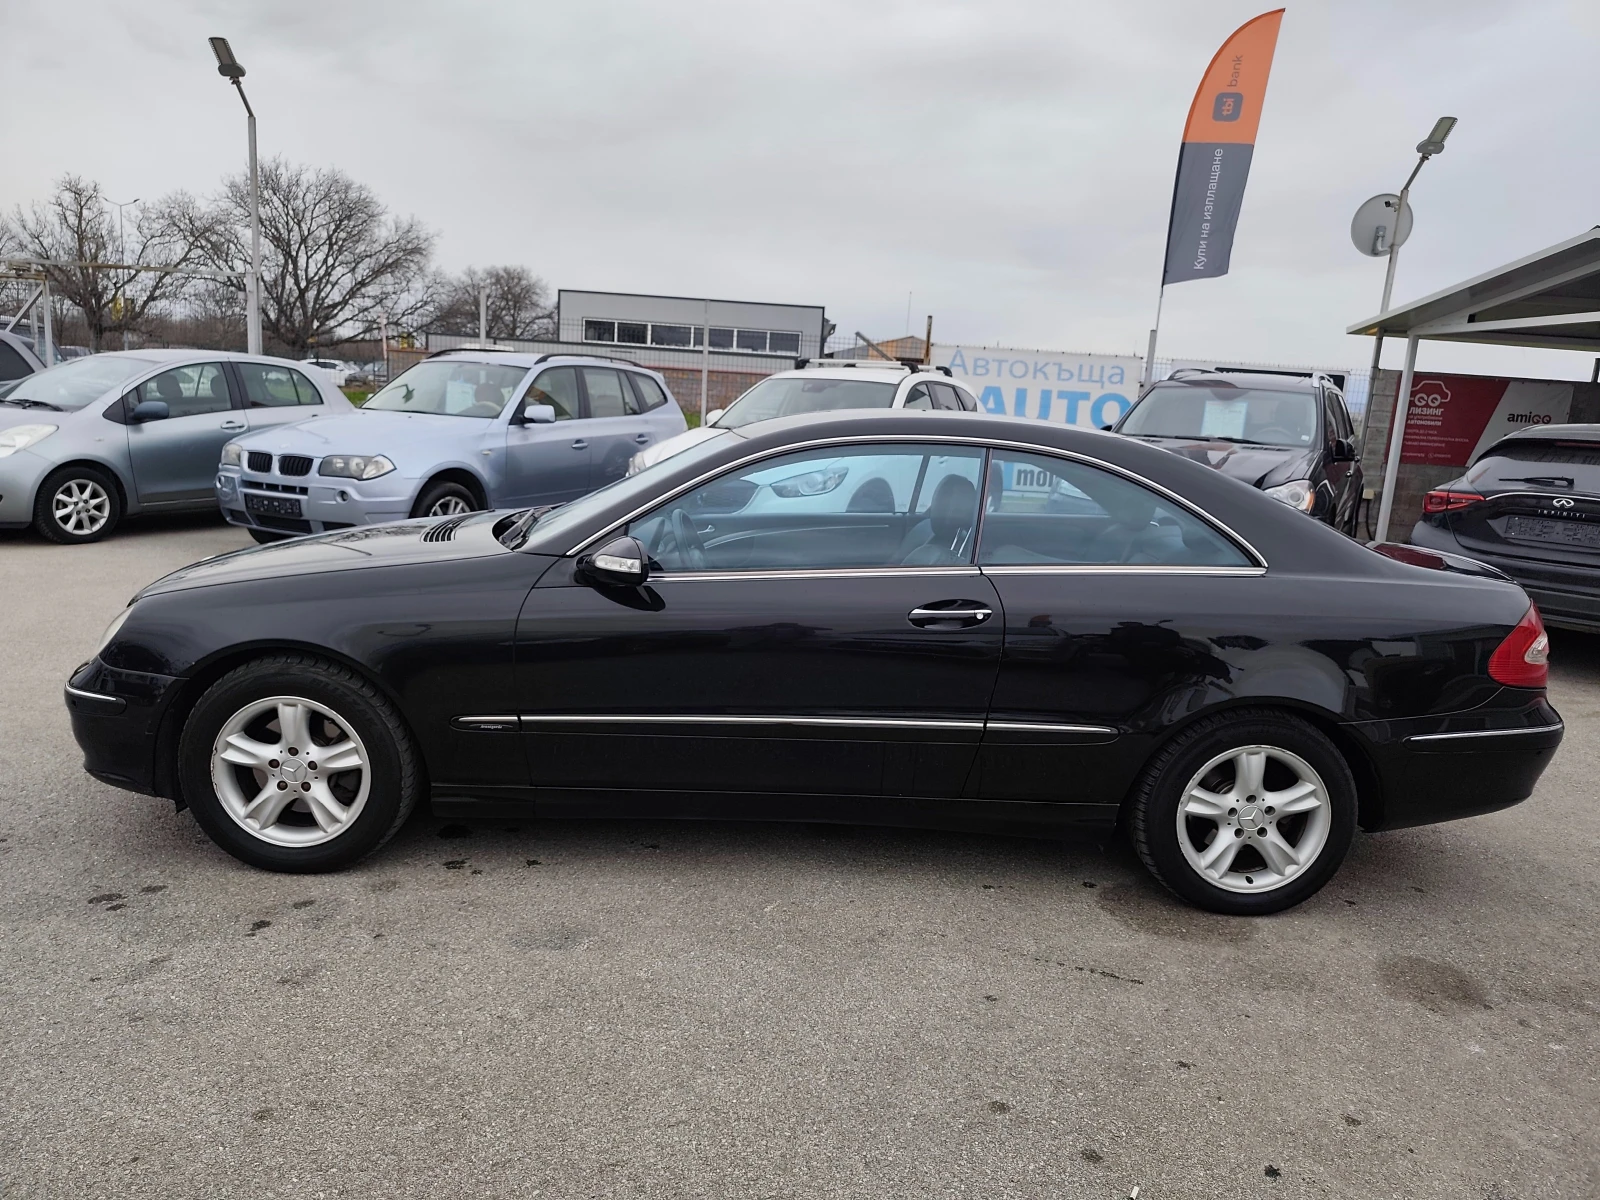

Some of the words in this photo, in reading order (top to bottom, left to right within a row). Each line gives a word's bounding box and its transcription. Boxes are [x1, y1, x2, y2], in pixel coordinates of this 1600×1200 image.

[1227, 55, 1243, 87] bank
[1222, 98, 1235, 116] tbi
[1204, 148, 1223, 220] изплащане
[1201, 223, 1210, 238] на
[1194, 241, 1207, 270] Купи
[949, 349, 1125, 389] Автокъща
[979, 386, 1132, 430] AUTO
[1409, 407, 1444, 416] ЛИЗИНГ
[1538, 509, 1585, 518] INFINITI
